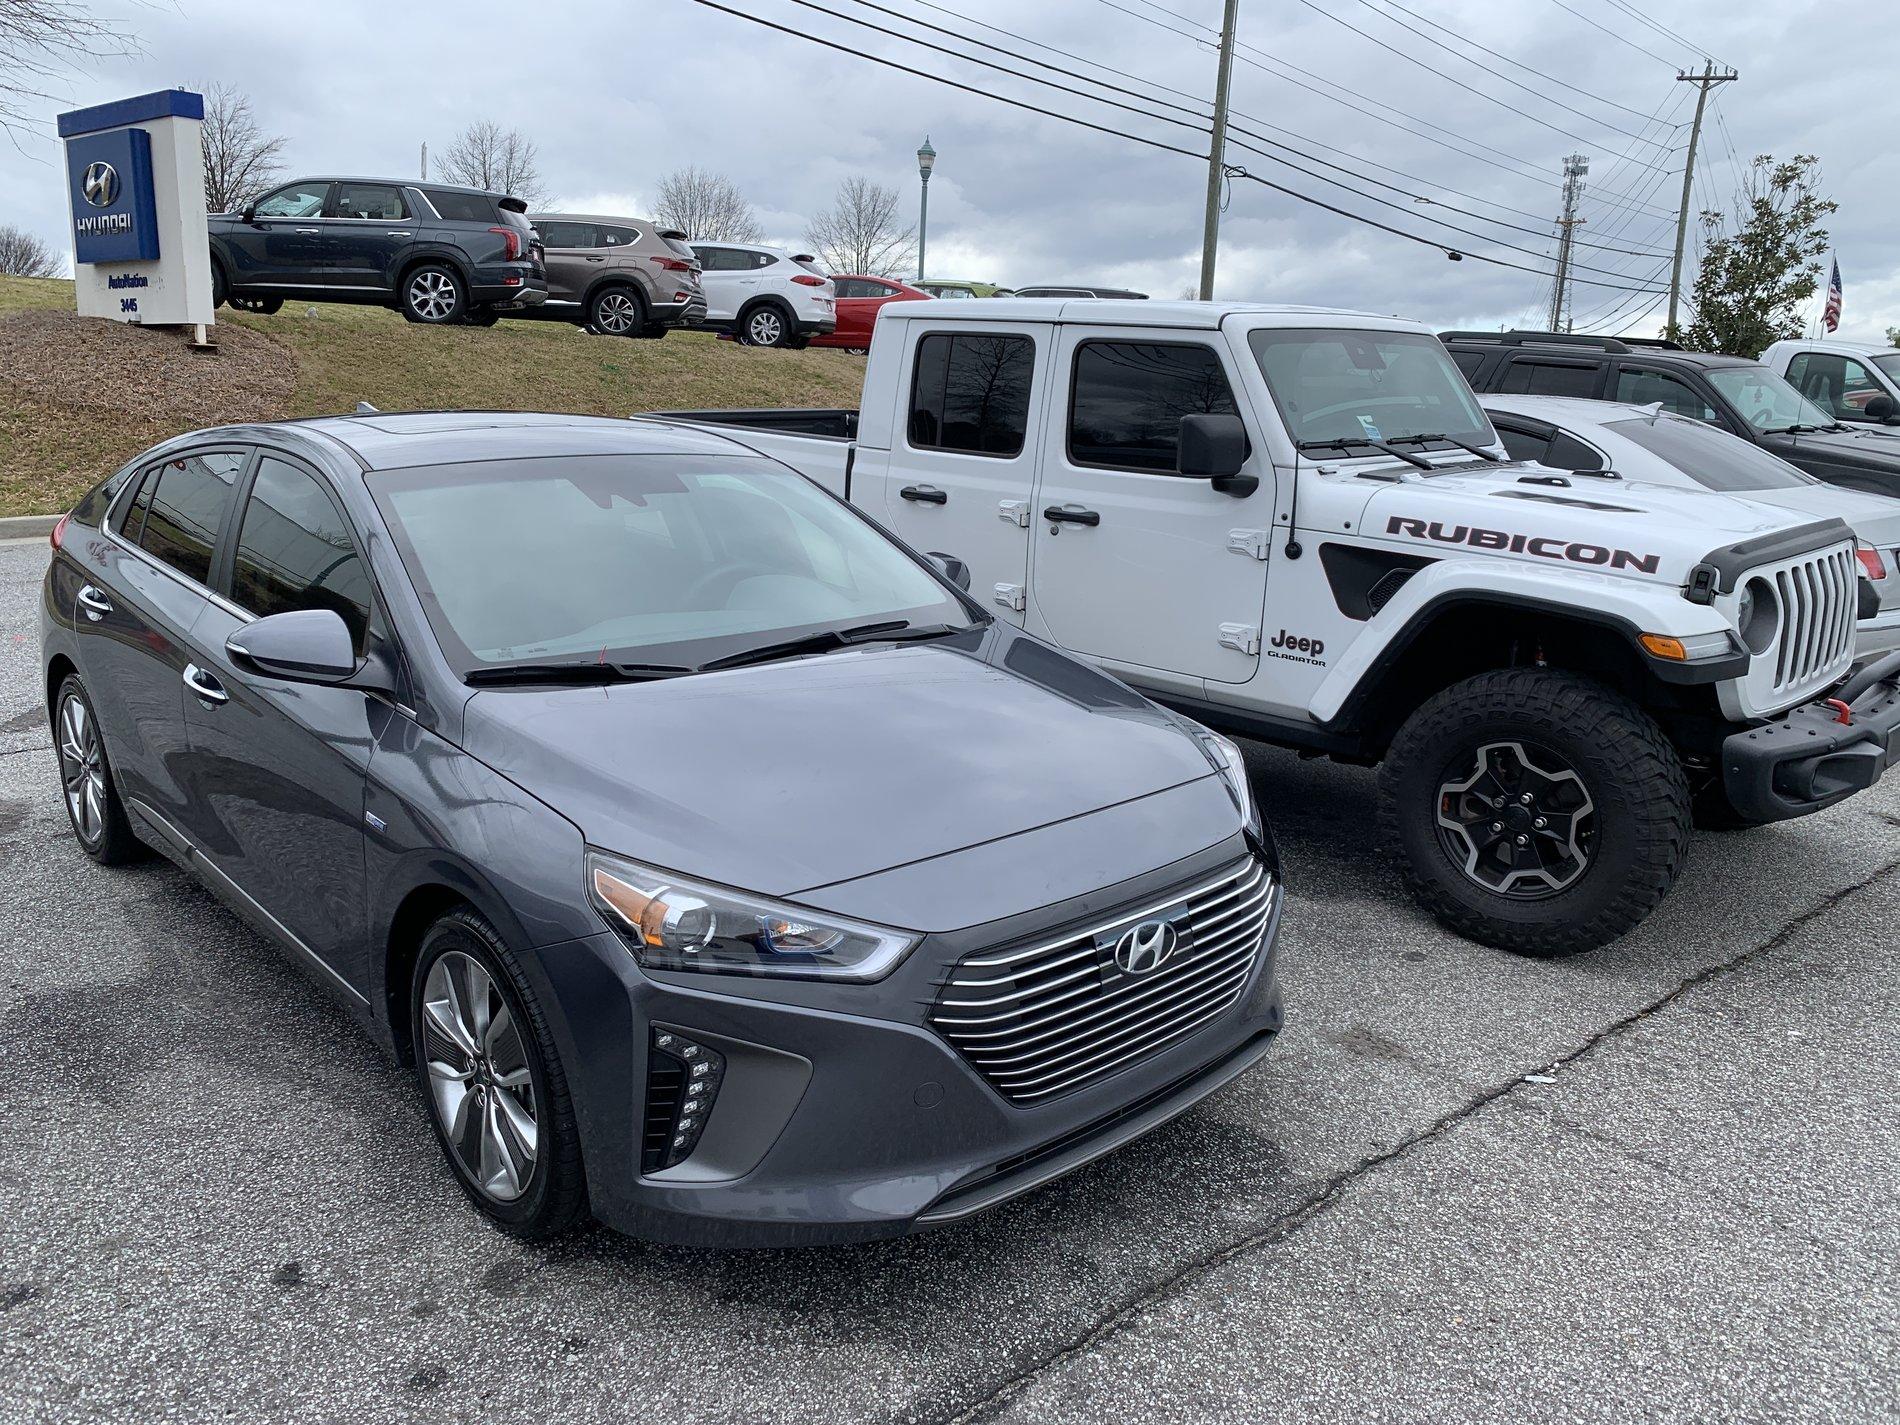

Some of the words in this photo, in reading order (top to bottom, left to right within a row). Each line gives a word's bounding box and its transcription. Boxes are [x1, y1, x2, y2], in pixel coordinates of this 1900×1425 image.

[77, 213, 131, 231] HYUNDAI
[108, 273, 148, 289] AutoNation
[1385, 515, 1661, 575] RUBICON
[1270, 629, 1325, 657] Jeep
[1267, 650, 1327, 668] GLADIATOR
